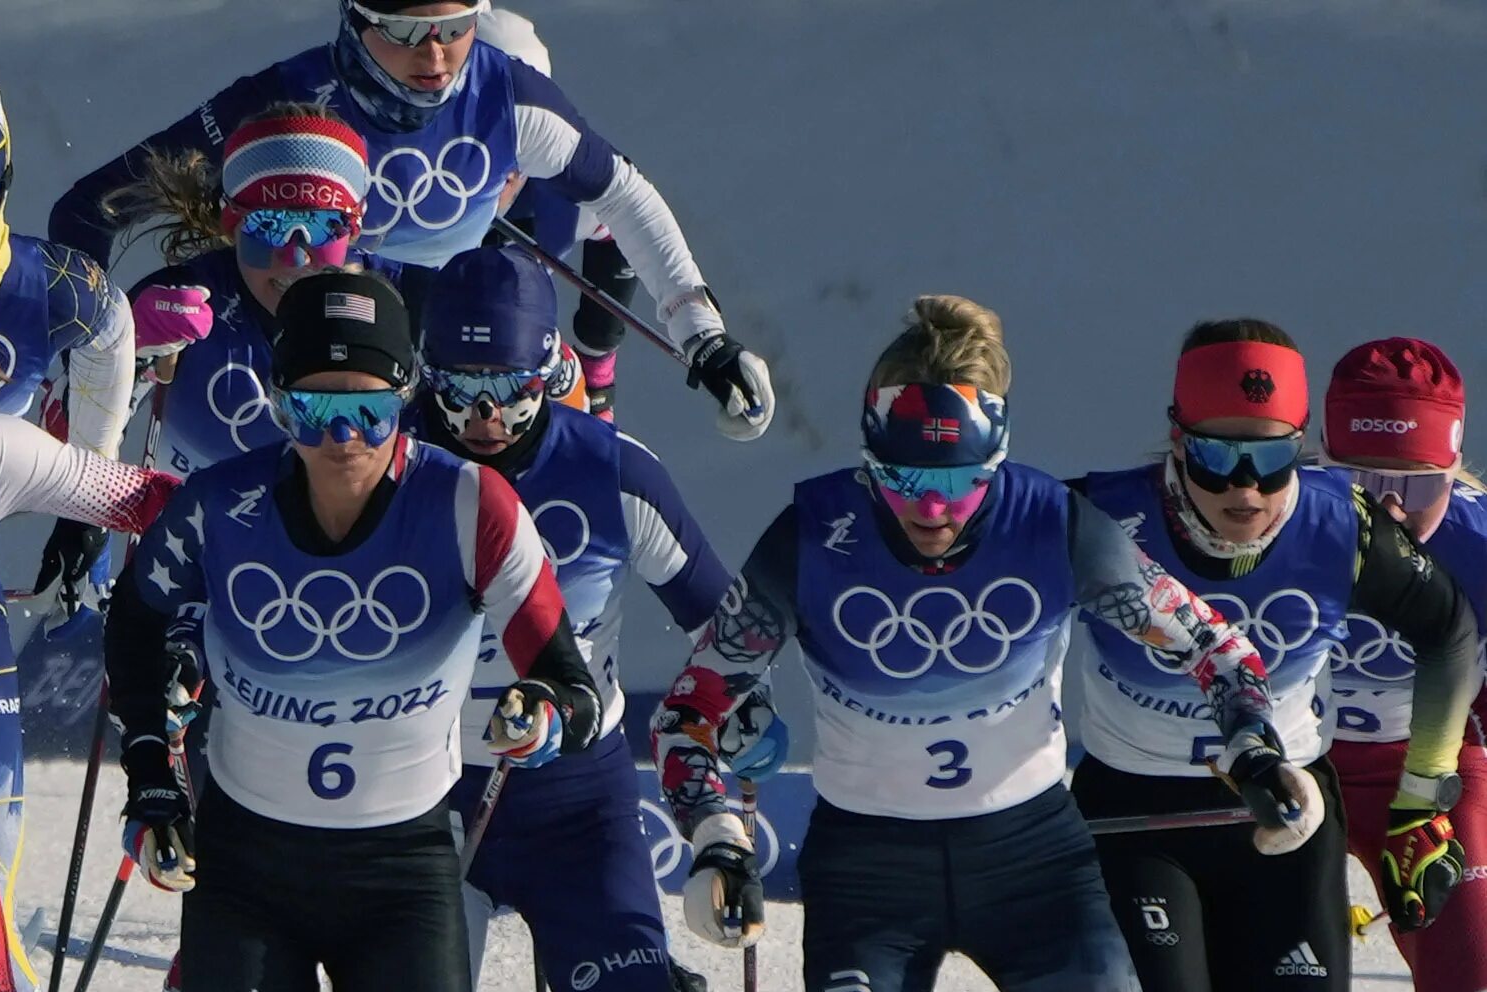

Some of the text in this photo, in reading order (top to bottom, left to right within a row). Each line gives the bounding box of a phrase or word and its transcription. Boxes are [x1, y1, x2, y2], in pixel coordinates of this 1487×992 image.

[263, 183, 343, 210] NORGE
[1350, 419, 1408, 434] BOSCO
[350, 679, 451, 724] 2022
[307, 742, 357, 800] 6
[925, 739, 972, 789] 3
[603, 948, 664, 972] HALTI
[1274, 963, 1328, 977] adidas
